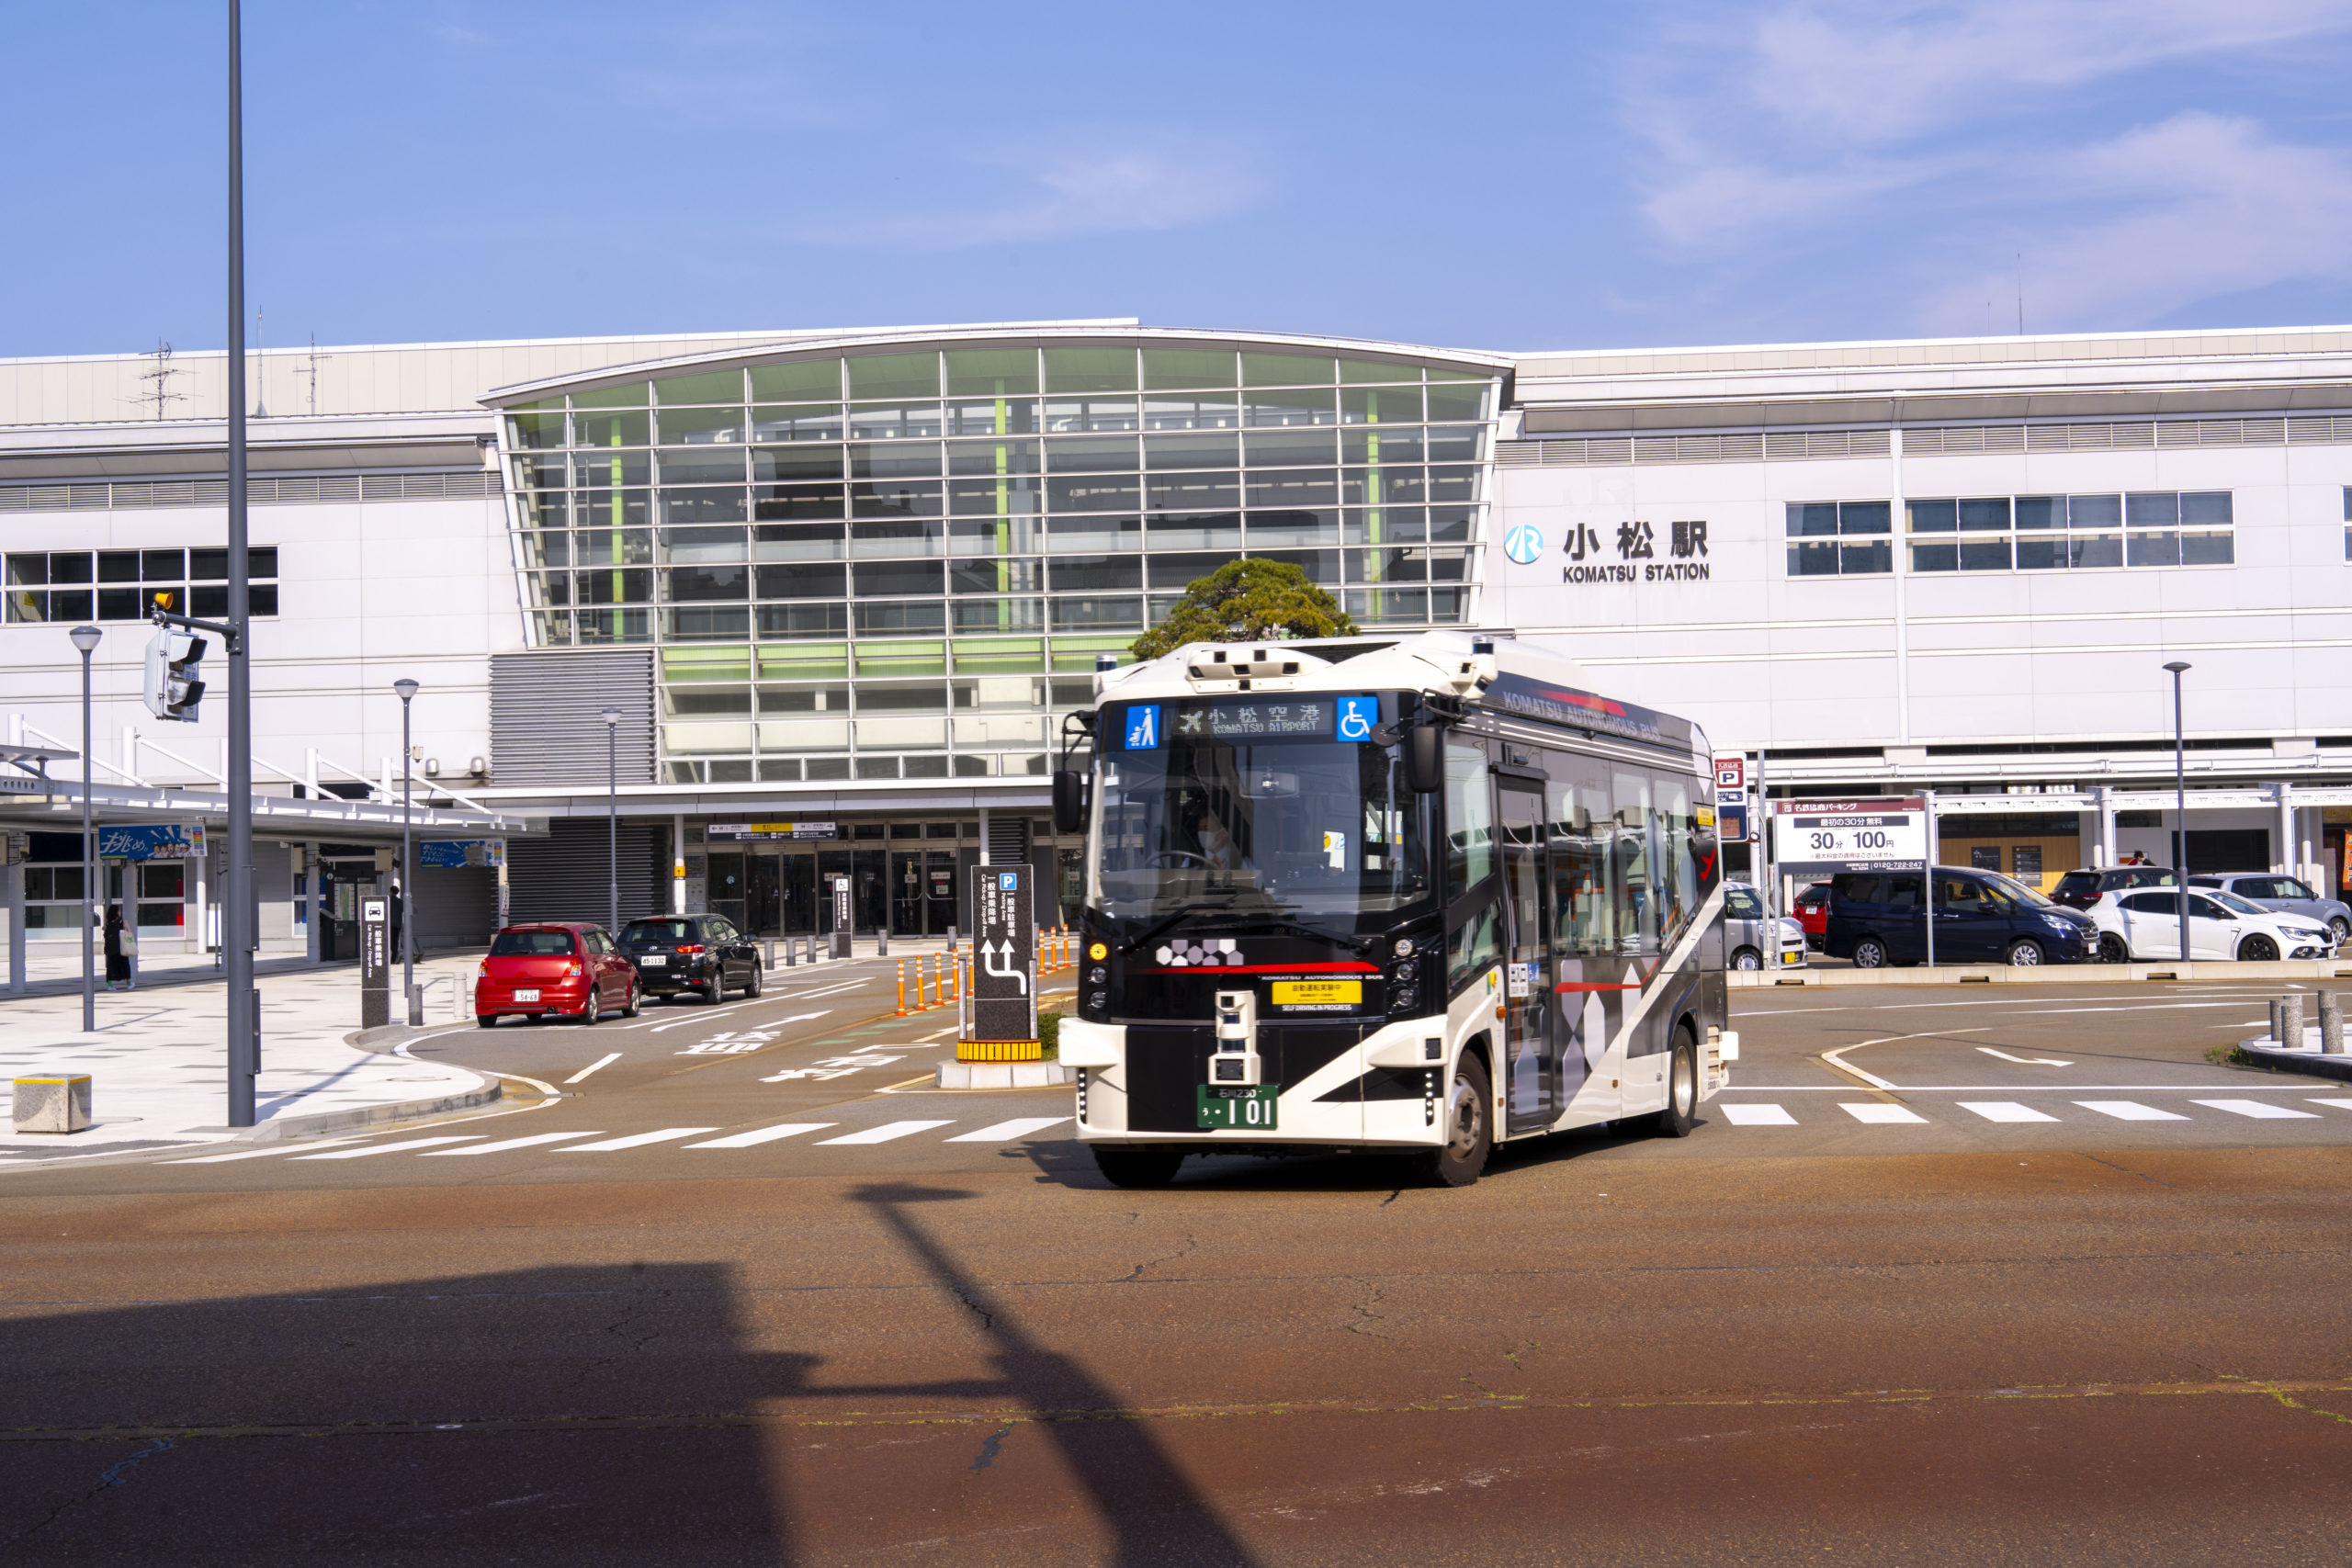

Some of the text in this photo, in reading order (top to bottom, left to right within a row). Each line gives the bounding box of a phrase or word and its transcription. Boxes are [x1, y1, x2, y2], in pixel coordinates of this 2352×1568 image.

[1563, 520, 1709, 561] 小松駅
[1563, 563, 1710, 583] KOMATSU STATION
[1208, 705, 1320, 725] 小松空港
[1503, 692, 1661, 741] KOMATSU AUTONOMOUS BUS
[1213, 721, 1317, 734] KOMATSU AIRPORT
[1723, 773, 1735, 783] P
[1794, 803, 1857, 812] 名鉄協商パーキング
[1003, 875, 1012, 888] P
[987, 876, 996, 925] 一般車乗降場
[1007, 893, 1015, 937] 一般車駐車場
[673, 1031, 783, 1055] 送迎
